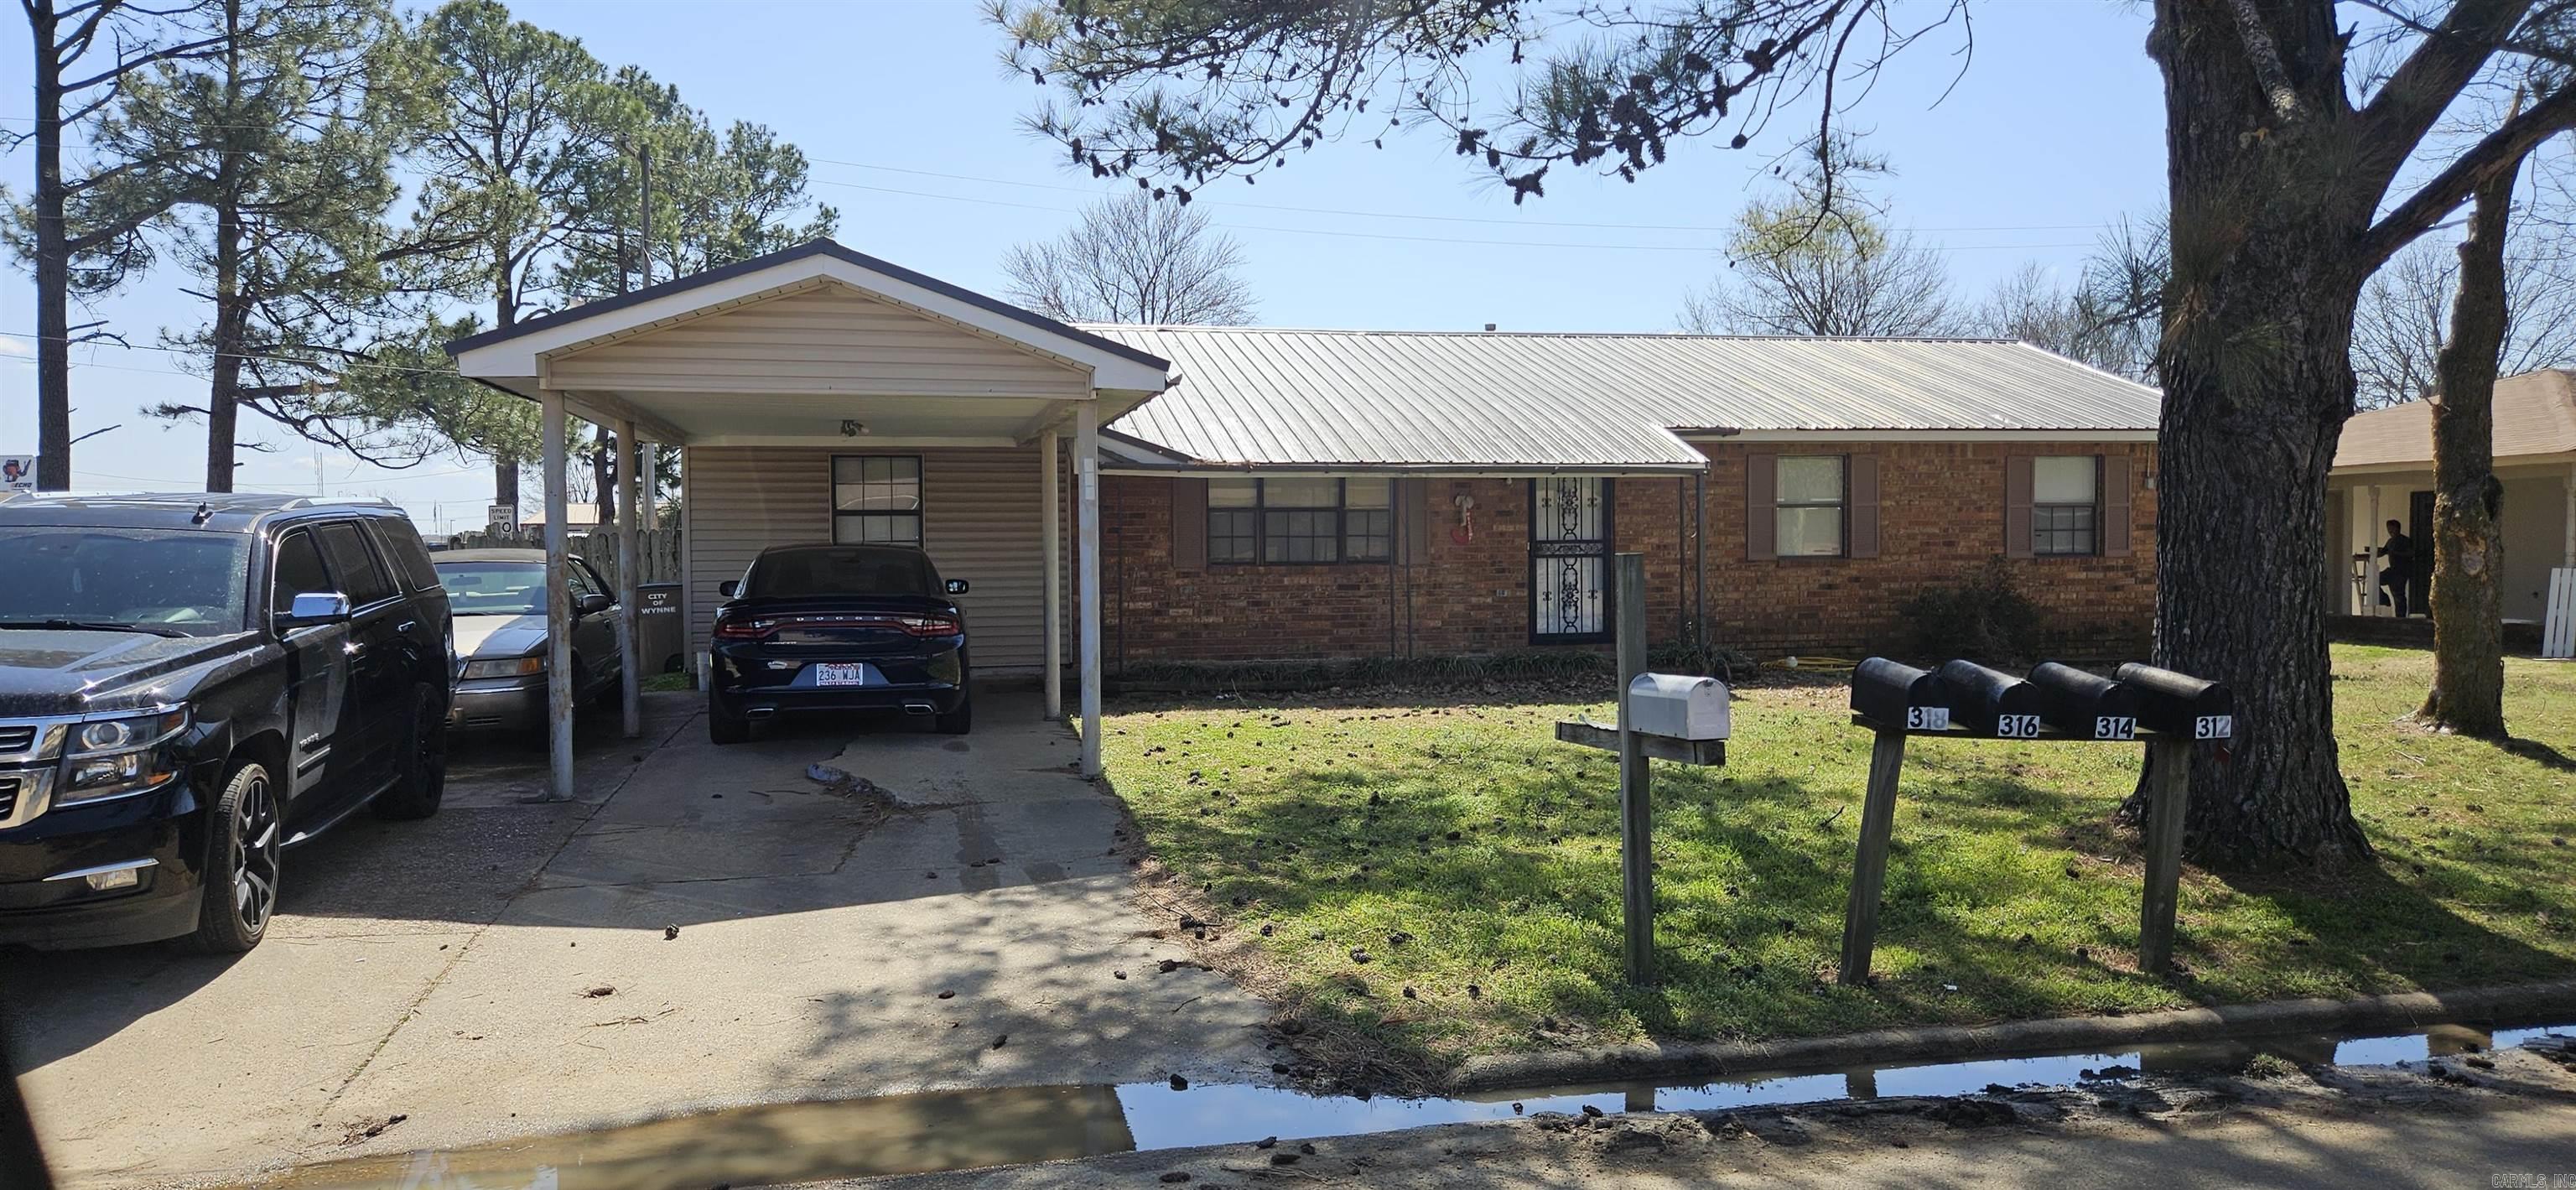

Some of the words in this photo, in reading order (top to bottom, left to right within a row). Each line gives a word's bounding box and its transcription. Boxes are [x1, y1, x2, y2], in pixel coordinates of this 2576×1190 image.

[641, 606, 677, 615] WYNNE
[818, 670, 837, 681] 236
[1909, 707, 1947, 728] 318
[2000, 715, 2038, 736] 316
[2097, 717, 2134, 738] 314
[2197, 717, 2231, 737] 312
